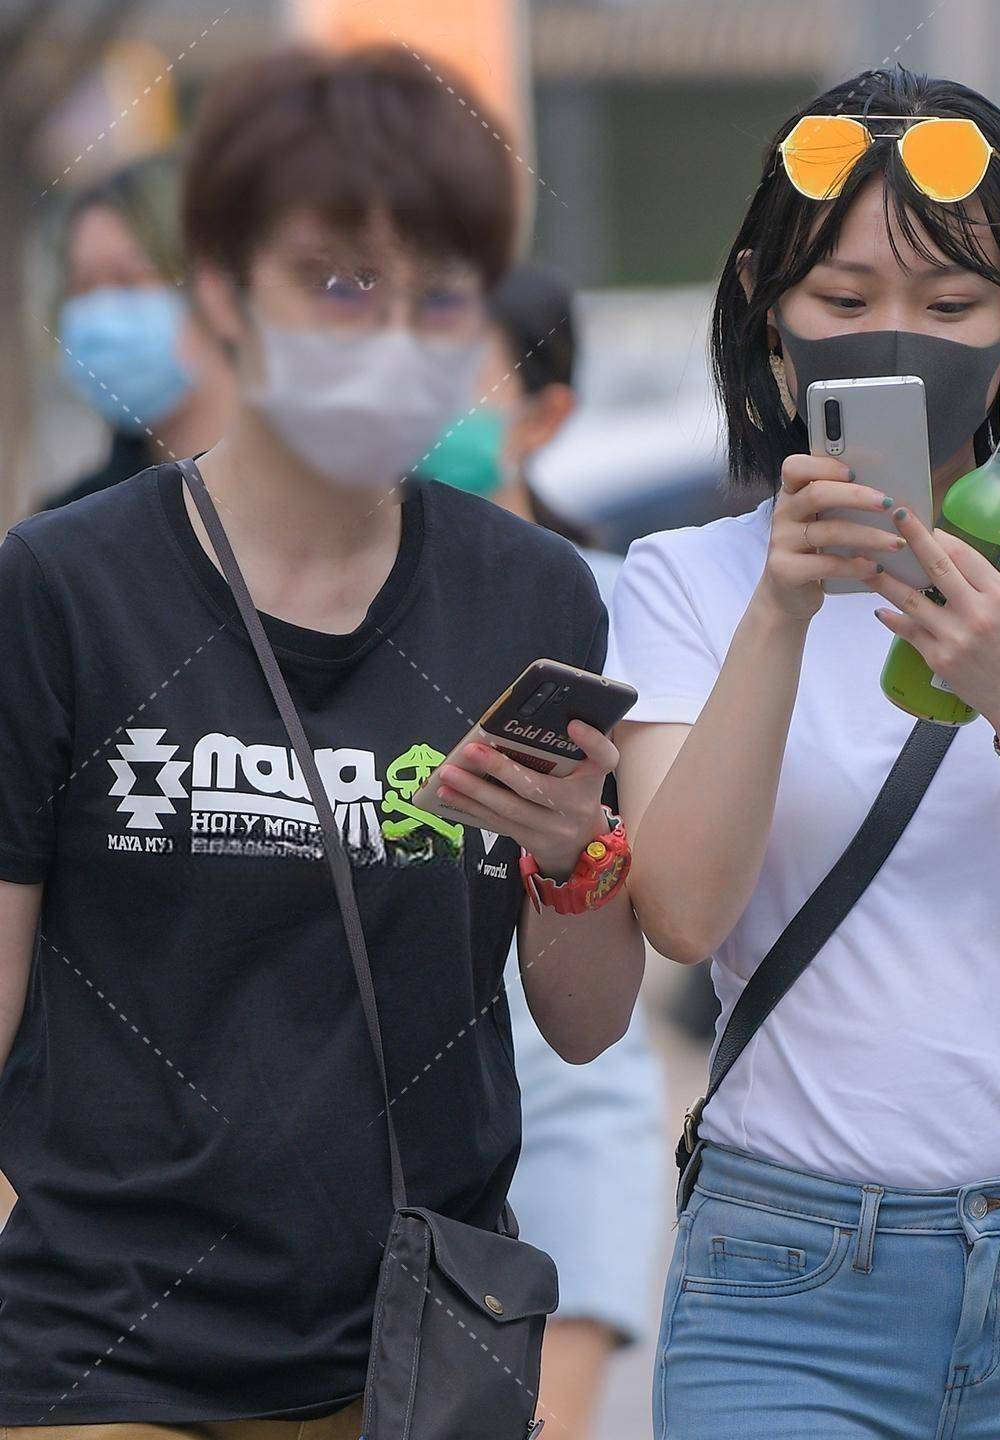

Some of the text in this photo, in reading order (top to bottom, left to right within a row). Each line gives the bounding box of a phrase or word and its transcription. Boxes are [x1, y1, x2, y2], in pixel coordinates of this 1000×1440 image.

[504, 719, 579, 753] Cold Brew
[108, 834, 143, 852] MAYA
